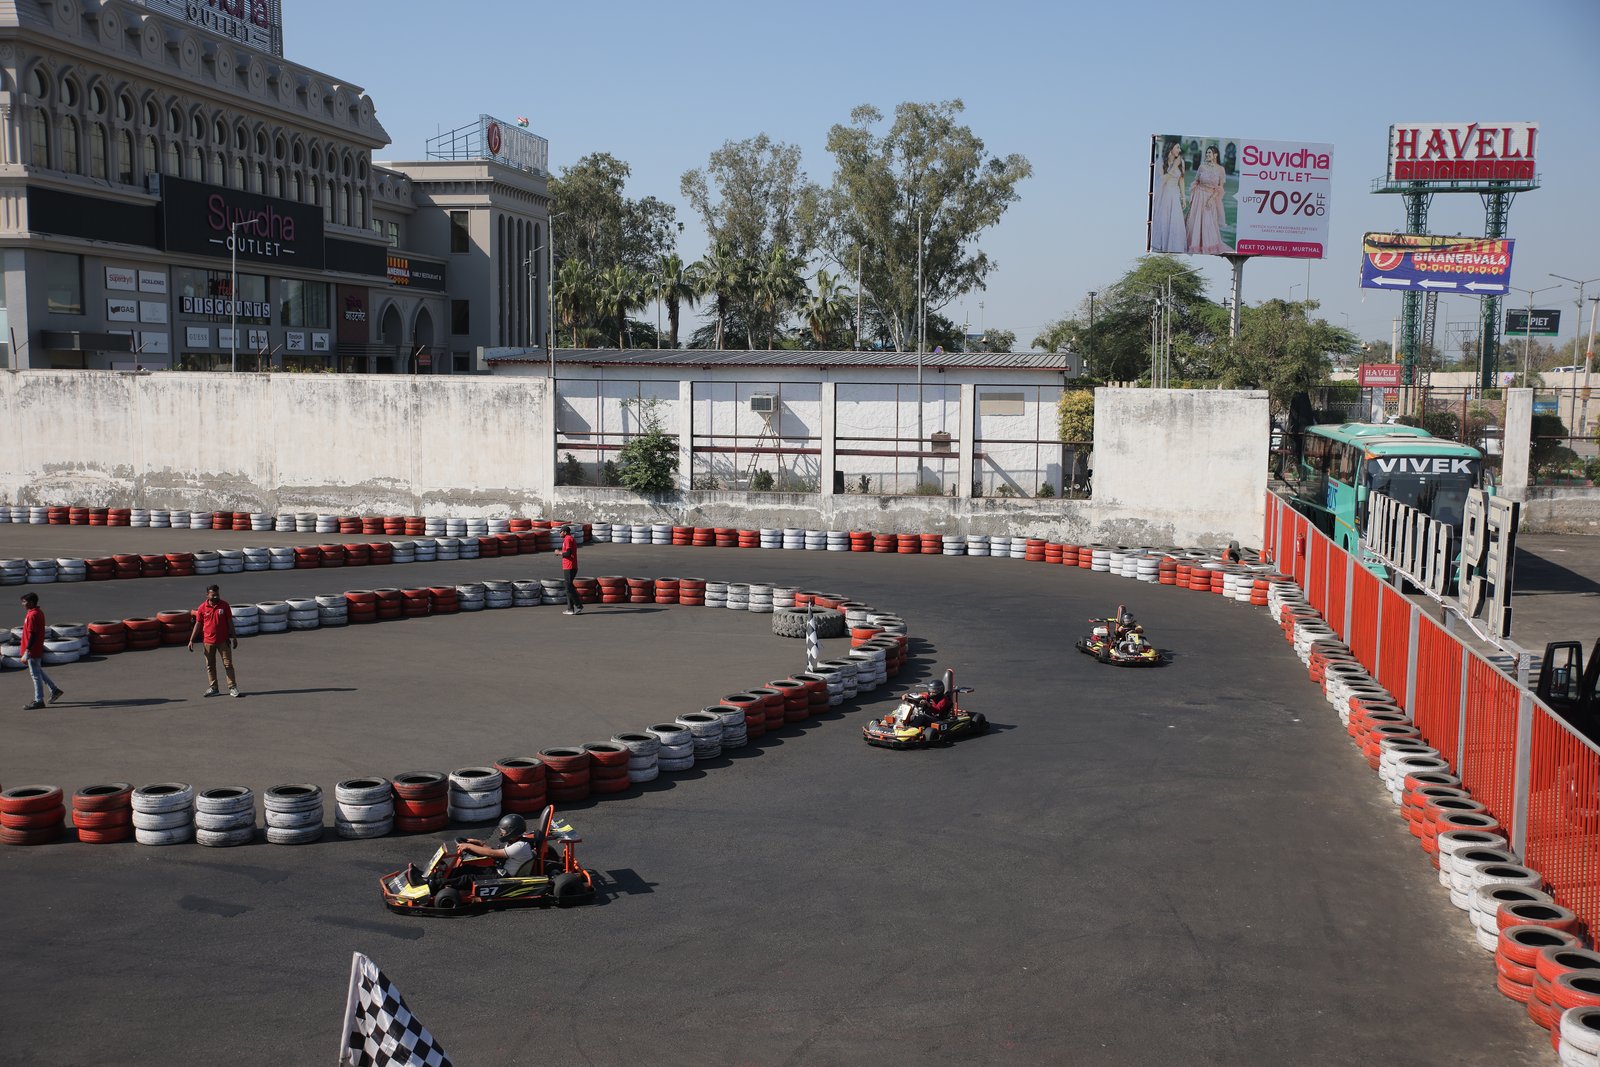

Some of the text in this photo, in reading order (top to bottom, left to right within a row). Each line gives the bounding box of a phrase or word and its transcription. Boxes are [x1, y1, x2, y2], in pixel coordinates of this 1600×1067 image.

[187, 4, 248, 41] OUTLET
[1396, 122, 1536, 160] HAVELI
[1242, 145, 1330, 170] Suvidha
[1259, 170, 1312, 183] OUTLET
[1243, 189, 1326, 217] UPTO 70% OFF
[208, 194, 295, 241] Suvidha
[226, 236, 281, 257] OUTLET
[1413, 252, 1507, 266] BIKANERVALA
[121, 305, 135, 314] GAS
[184, 297, 270, 317] DISCOUNTS
[1530, 317, 1549, 326] PIET
[189, 333, 208, 341] GUESS
[1365, 368, 1396, 376] HAVELI
[1376, 458, 1473, 474] VIVEK
[480, 887, 499, 896] 27
